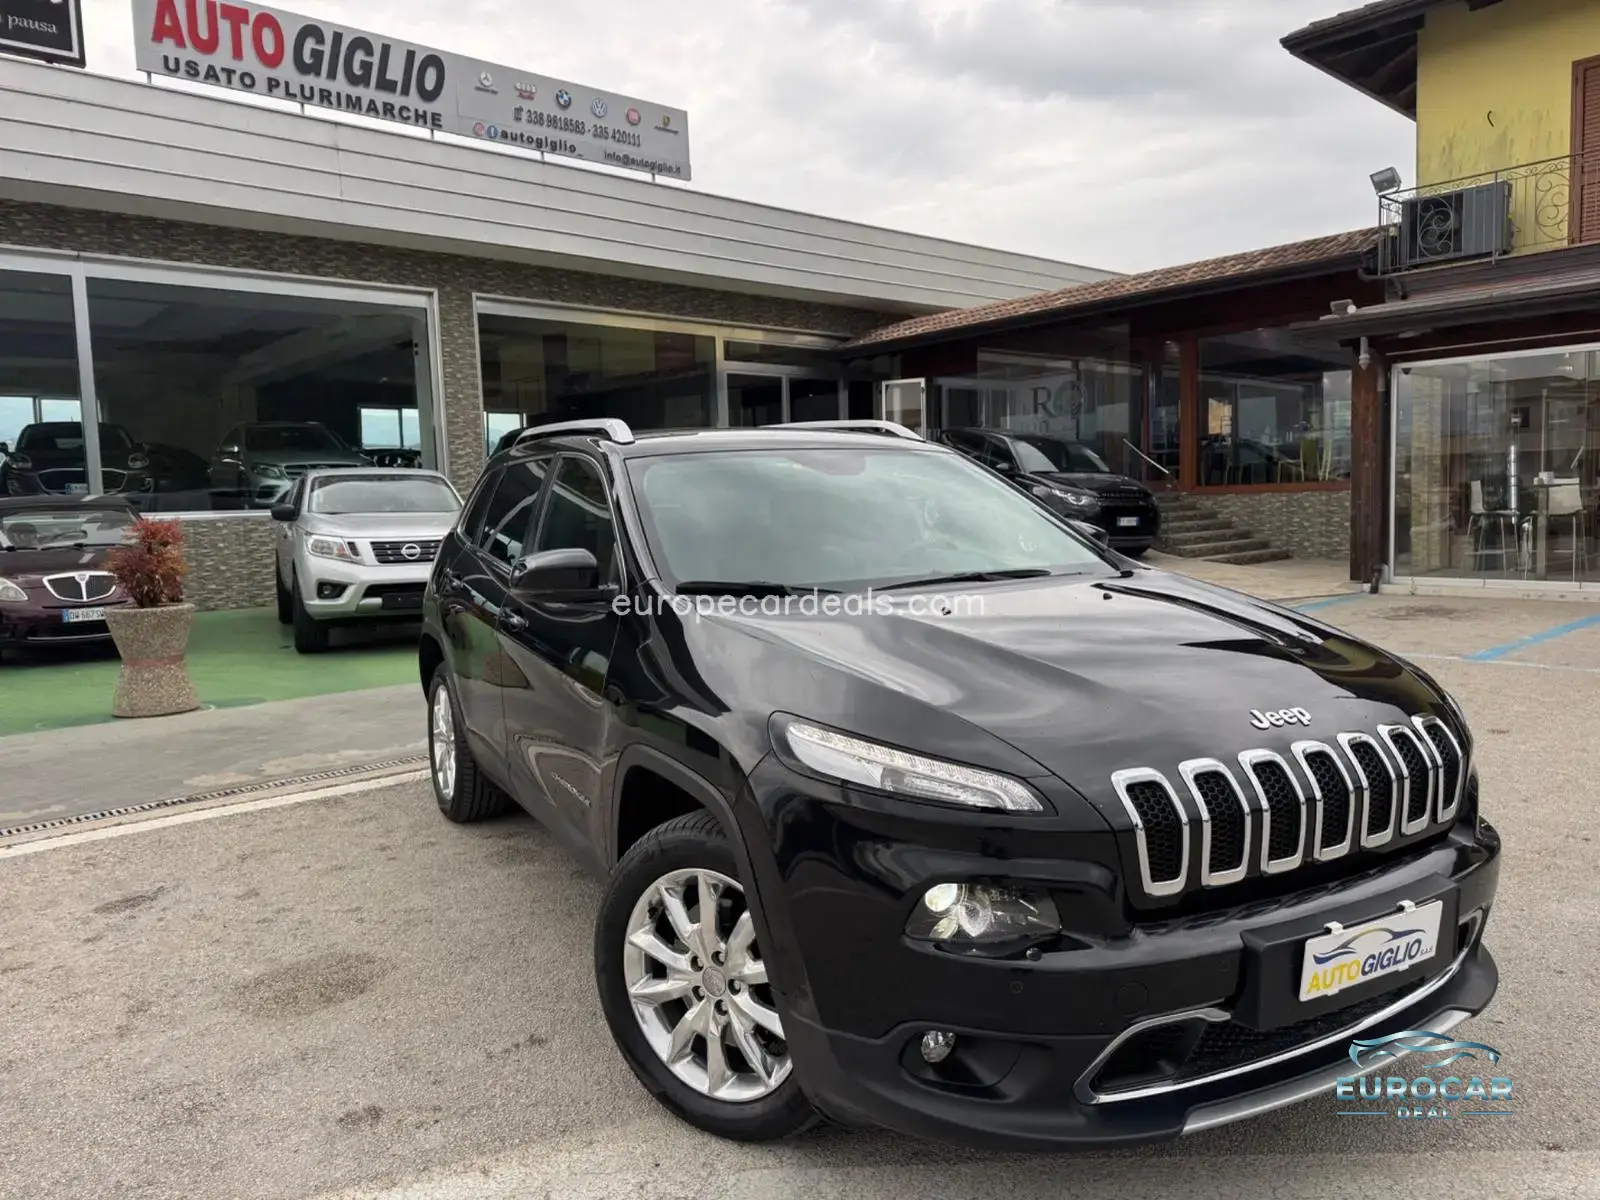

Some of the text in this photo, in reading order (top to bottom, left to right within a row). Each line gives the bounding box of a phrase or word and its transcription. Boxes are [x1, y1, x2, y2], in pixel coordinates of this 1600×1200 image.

[7, 14, 58, 34] pausa
[151, 0, 446, 102] AUTO GIGLIO
[162, 54, 443, 128] USATO PLURIMARCHE
[1249, 707, 1312, 730] Jeep
